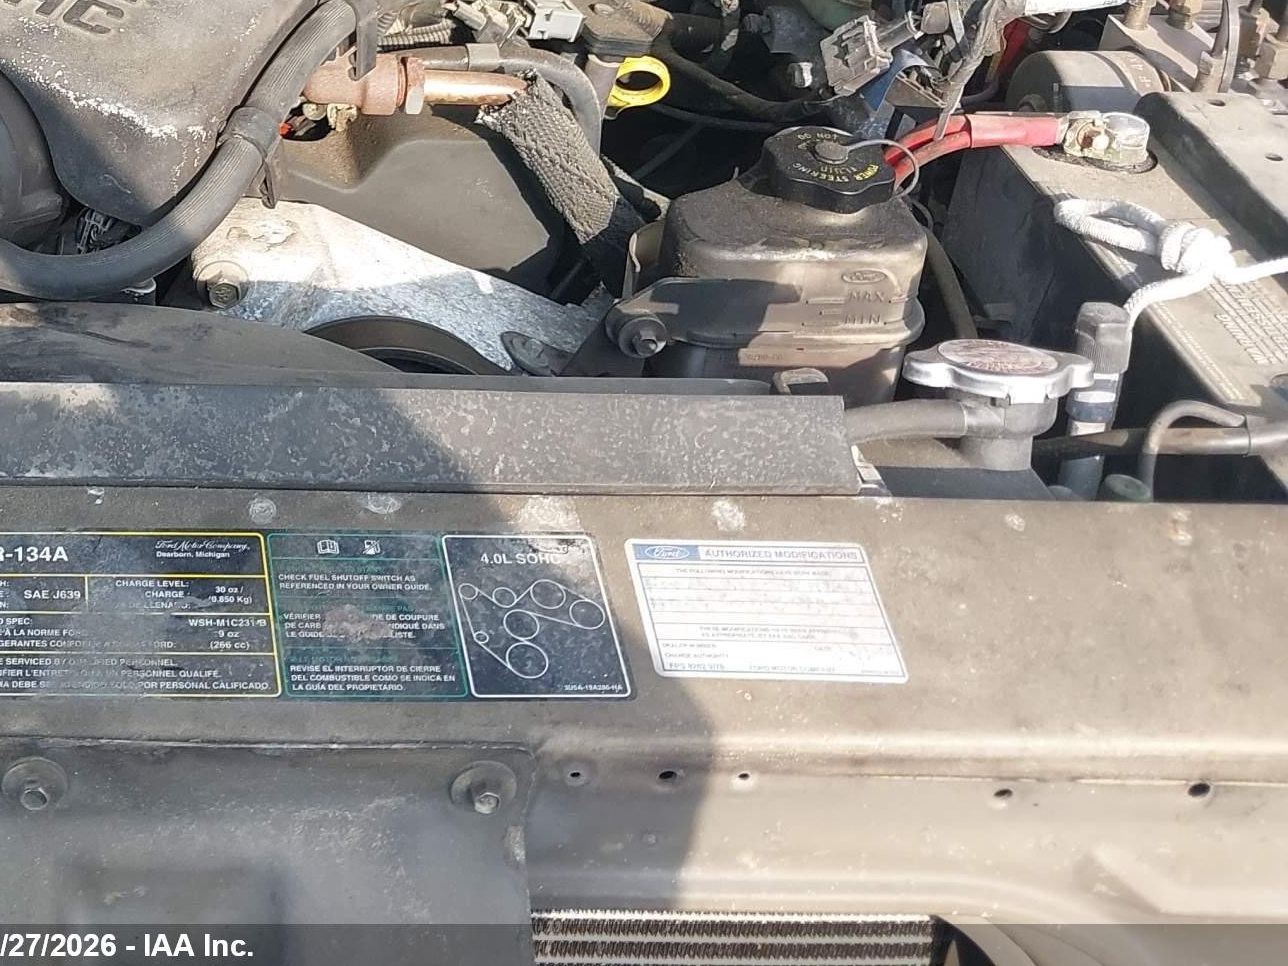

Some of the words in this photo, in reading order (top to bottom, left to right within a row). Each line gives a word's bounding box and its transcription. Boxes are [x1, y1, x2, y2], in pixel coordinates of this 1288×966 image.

[792, 162, 850, 183] STEERING
[853, 163, 880, 182] POWER
[848, 290, 886, 304] MAX
[1214, 313, 1268, 365] WARNING
[154, 540, 176, 550] Ford
[178, 540, 204, 550] Motor
[156, 551, 194, 560] Dearborn,
[196, 551, 230, 560] Michigan
[653, 546, 682, 559] Ford
[704, 548, 773, 560] AUTHORIZED
[774, 550, 859, 561] MODIFICATIONS
[480, 553, 513, 565] 4.0L
[516, 553, 564, 566] SOHC
[278, 573, 307, 582] CHECK
[308, 574, 330, 582] FUEL
[331, 574, 370, 582] SHUTOFF
[370, 574, 403, 582] SWITCH
[115, 580, 155, 588] CHARGE
[156, 580, 190, 588] LEVEL:
[279, 582, 336, 590] REFERENCED
[371, 583, 403, 591] OWNER
[24, 590, 50, 600] SAE
[52, 590, 81, 600] J639
[144, 590, 185, 598] CHARGE
[6, 618, 33, 626] SPEC:
[27, 629, 60, 637] NORME
[5, 658, 52, 666] SERVICED
[290, 664, 322, 673] REVISE
[334, 664, 394, 673] INTERRUPTOR
[409, 665, 442, 673] CIERRE
[310, 674, 370, 682] COMBUSTIBLE
[372, 674, 398, 682] COMO
[412, 674, 442, 682] INDICA
[12, 680, 38, 689] DEBE
[160, 682, 211, 690] PERSONAL
